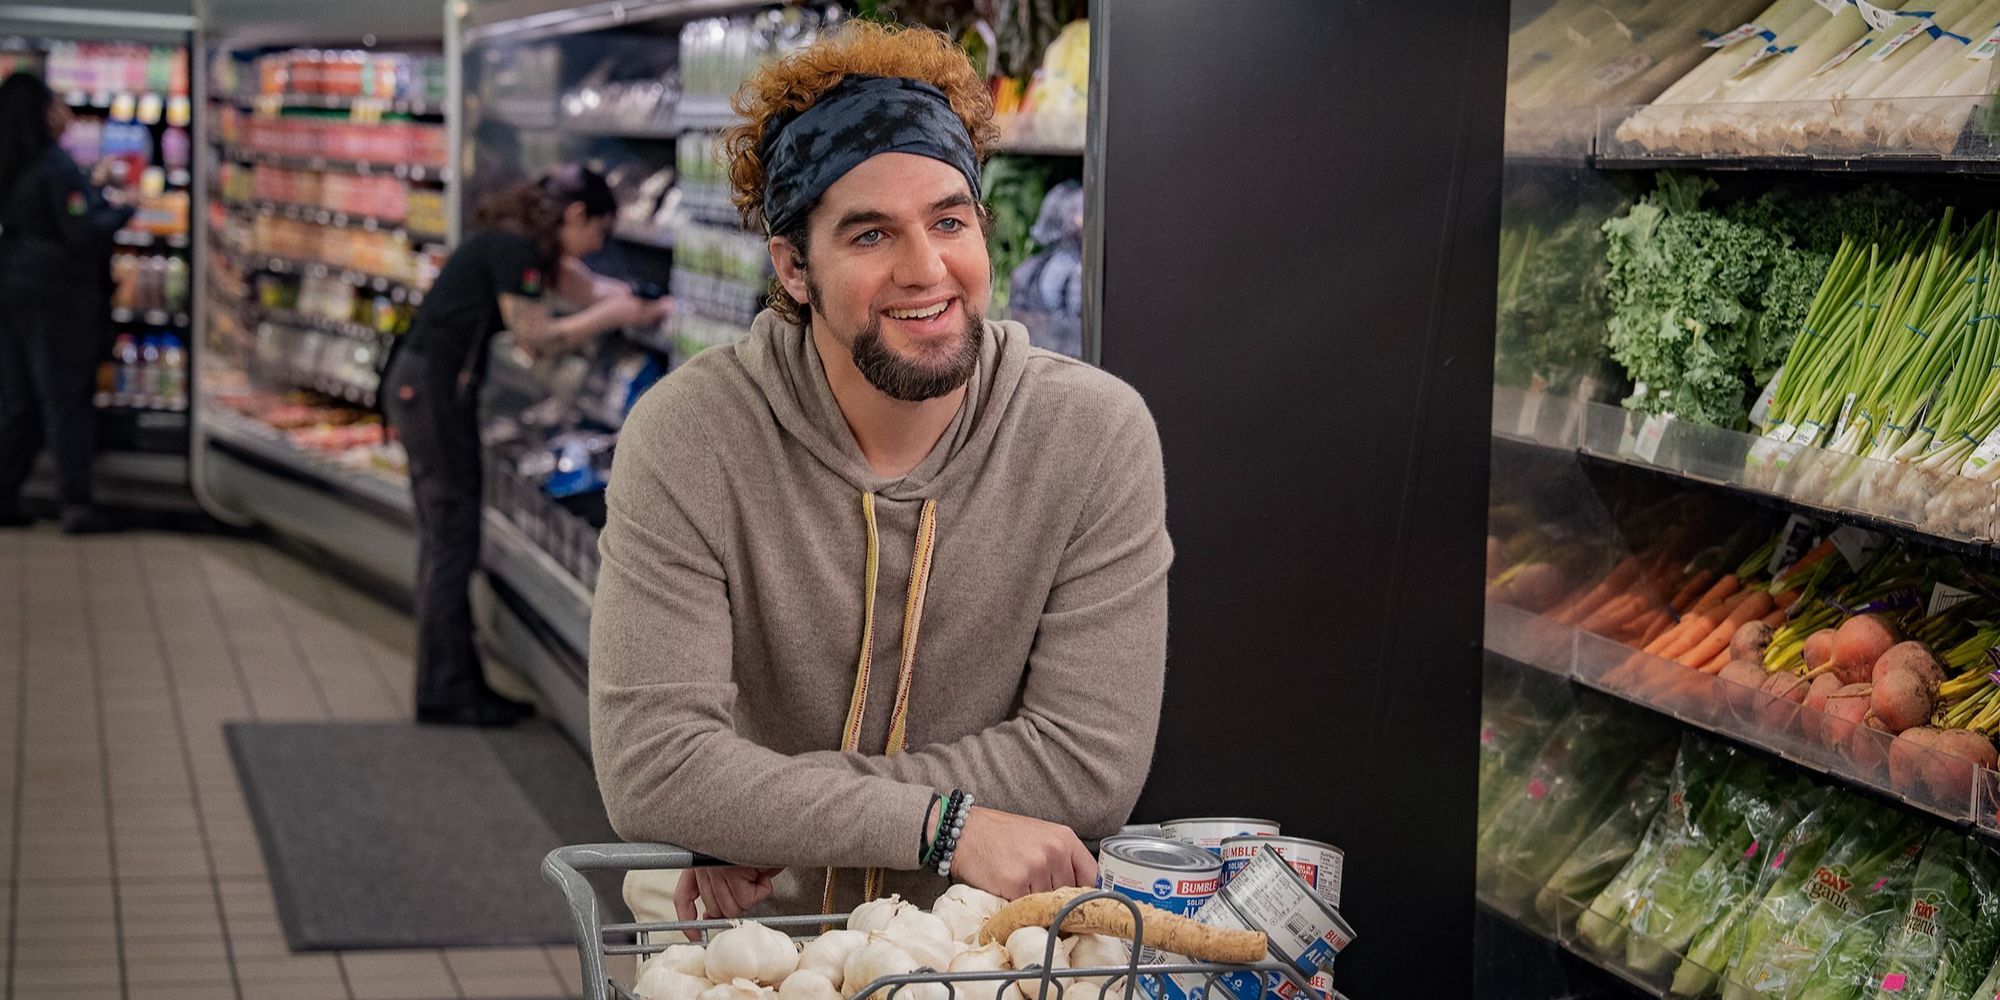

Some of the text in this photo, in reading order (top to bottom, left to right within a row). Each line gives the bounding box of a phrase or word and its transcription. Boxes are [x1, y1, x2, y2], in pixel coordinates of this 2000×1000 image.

[1181, 880, 1217, 894] BUMBLE
[1813, 867, 1853, 893] FOXY
[1309, 976, 1325, 989] BEE
